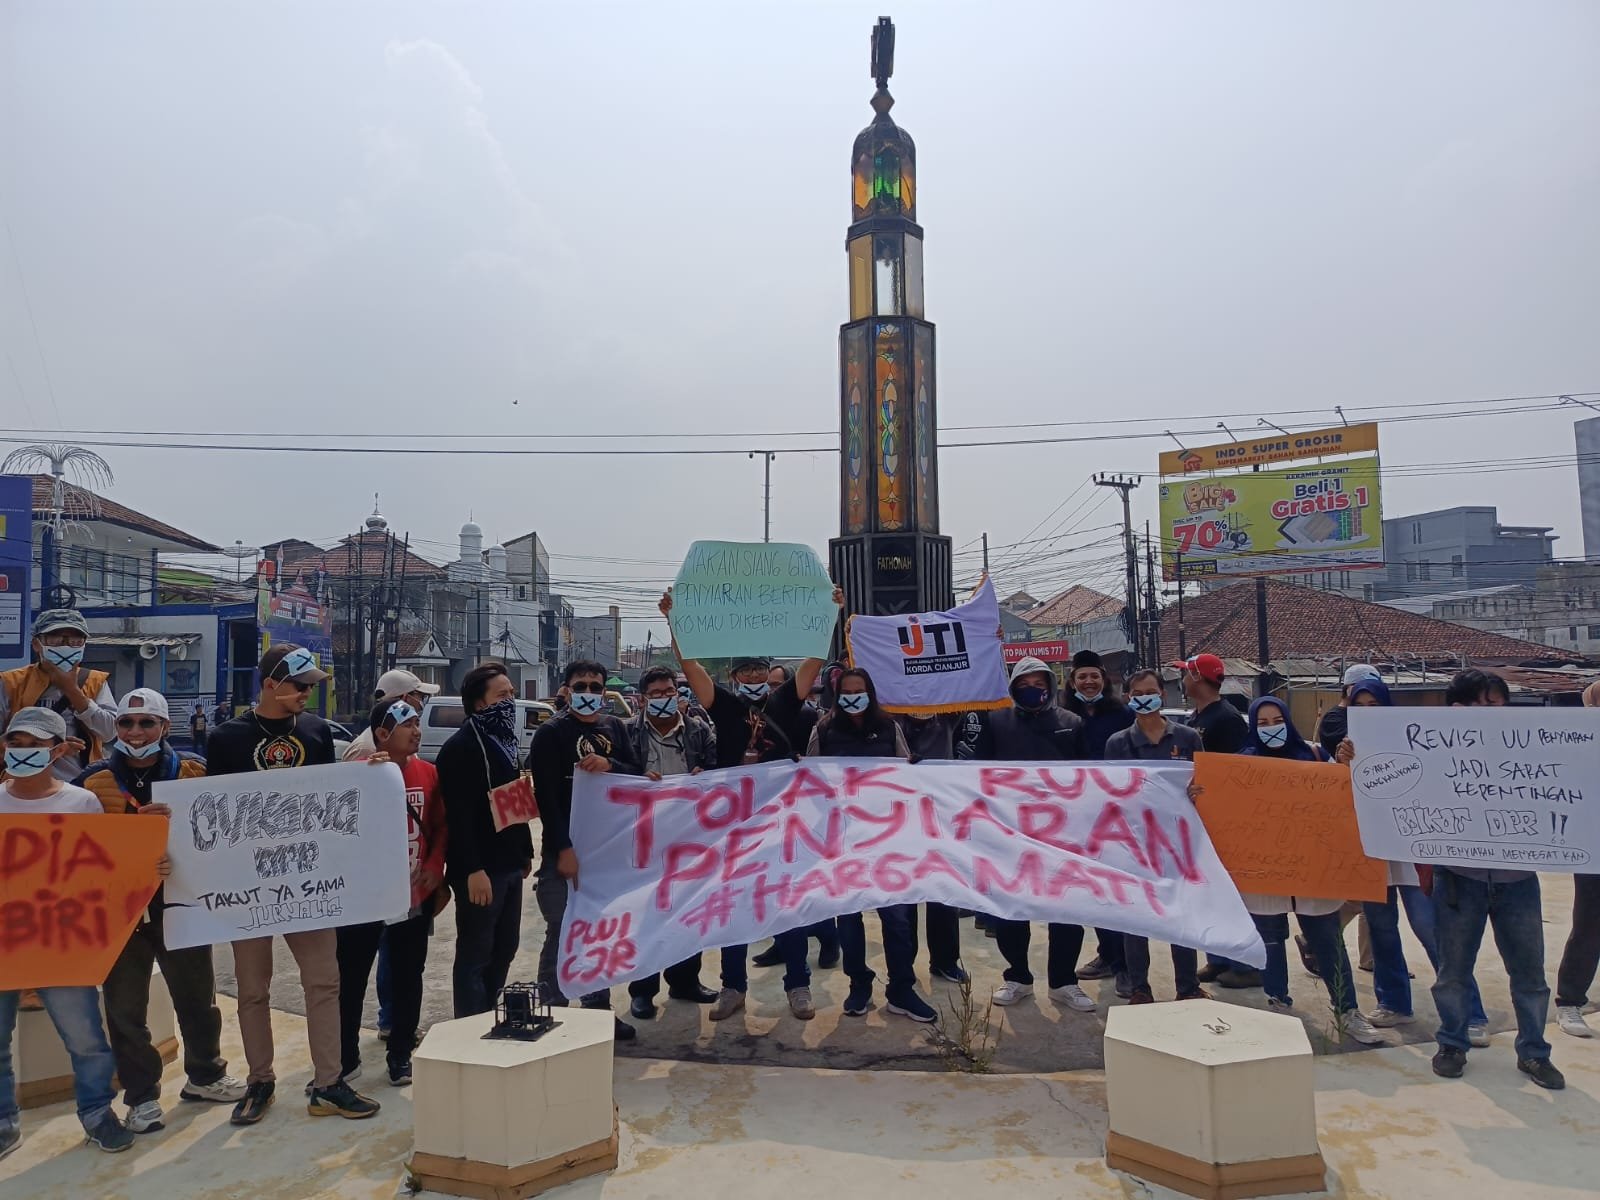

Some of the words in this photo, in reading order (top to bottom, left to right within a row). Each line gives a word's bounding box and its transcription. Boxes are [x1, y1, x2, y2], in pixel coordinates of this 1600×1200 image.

[1216, 447, 1246, 459] INDO
[1252, 442, 1289, 454] SUPER
[1295, 433, 1343, 447] GROSIR
[1217, 454, 1265, 466] SUPERMARKET
[1184, 482, 1223, 504] BIG
[1295, 479, 1329, 497] Beli
[1332, 478, 1343, 494] 1
[1189, 497, 1225, 514] SALE
[1271, 490, 1350, 519] Gratis
[1354, 487, 1368, 506] 1
[744, 550, 781, 577] SIANG
[877, 556, 912, 570] FATHONAH
[676, 582, 753, 610] PENYIARAN
[697, 615, 723, 632] MAU
[1014, 647, 1028, 656] PAK
[1028, 646, 1050, 656] KUMIS
[1050, 645, 1063, 655] 777
[906, 664, 933, 674] KORDA
[934, 661, 968, 671] CIANJUR
[1406, 723, 1485, 751] REVISI
[1501, 729, 1532, 749] UU
[1444, 757, 1491, 779] JADI
[1500, 761, 1565, 780] SARAT
[189, 786, 361, 852] CUKONG
[606, 766, 918, 869] TOLAK
[979, 767, 1146, 800] RUU
[1485, 809, 1538, 837] DPR
[253, 840, 320, 880] DPR
[656, 795, 1204, 910] PENYIARAN
[1418, 843, 1442, 857] RUU
[197, 887, 262, 911] TAKUT
[268, 884, 295, 904] YA
[301, 875, 346, 896] SAMA
[560, 939, 637, 981] CJR
